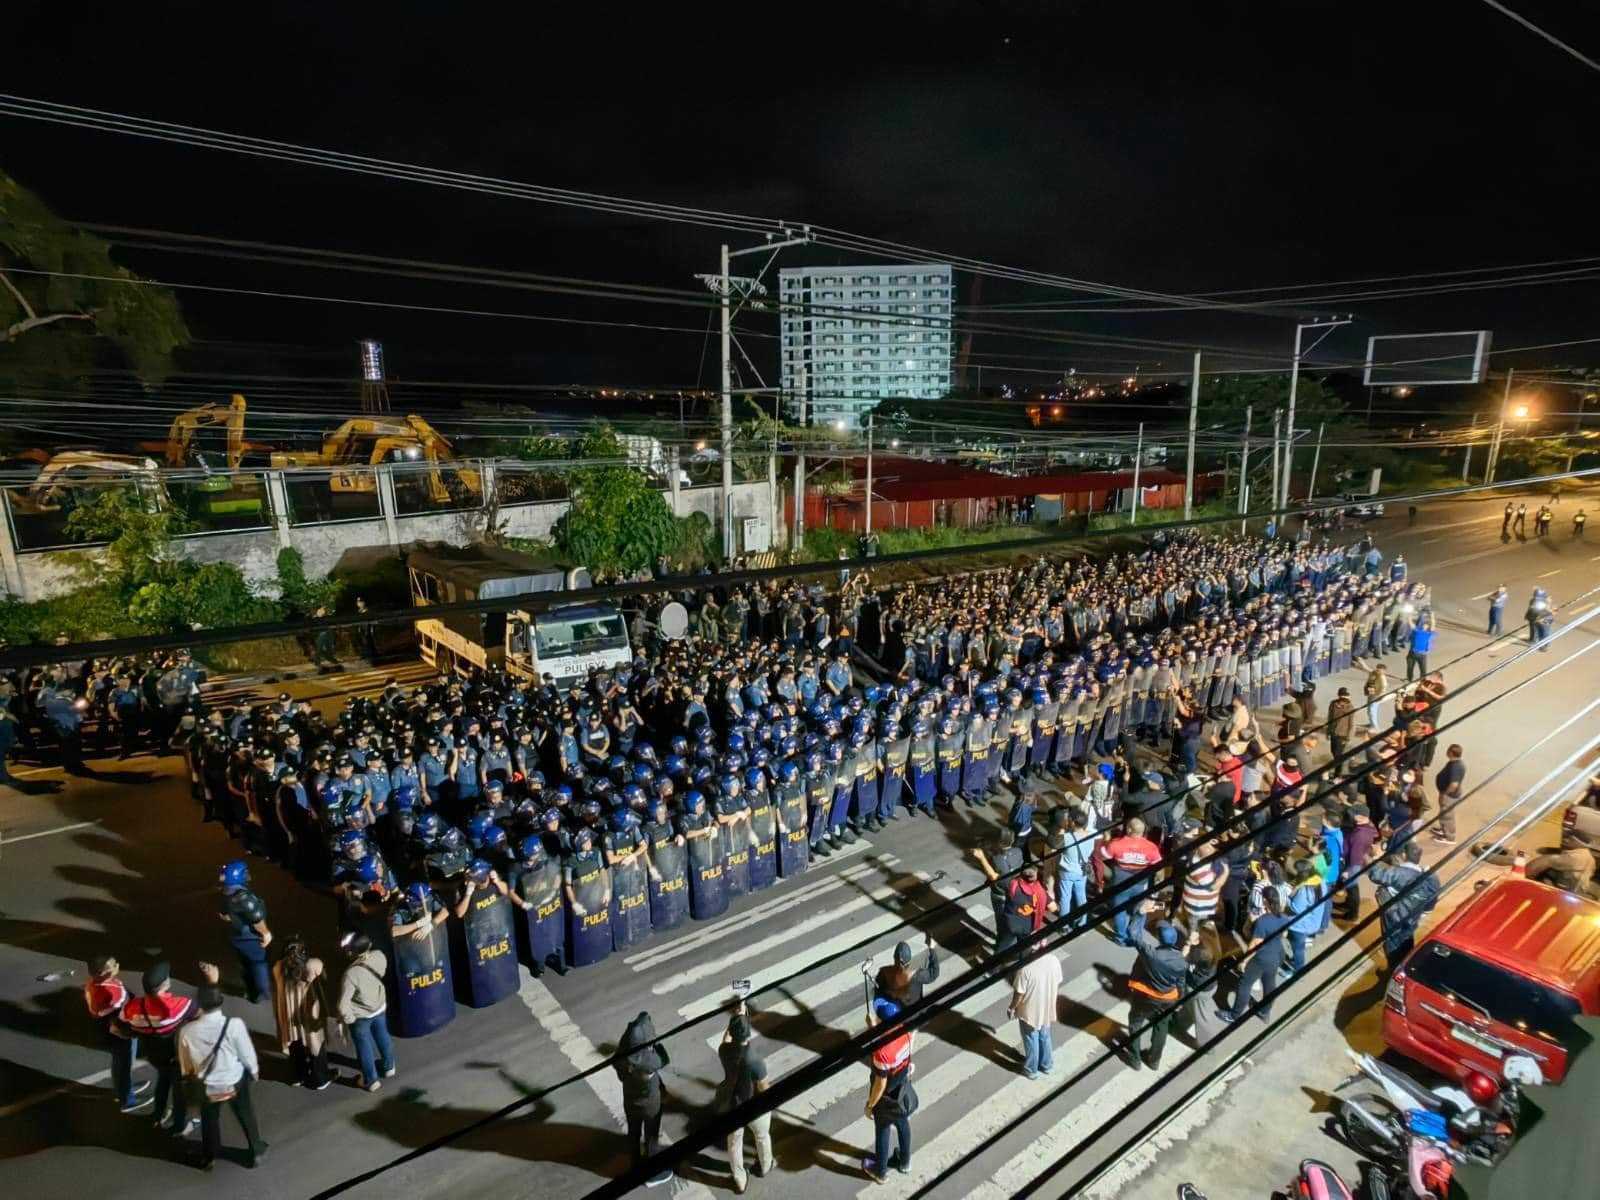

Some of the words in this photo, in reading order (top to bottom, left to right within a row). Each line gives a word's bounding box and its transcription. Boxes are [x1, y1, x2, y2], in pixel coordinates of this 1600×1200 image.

[660, 877, 684, 893] PULIS
[476, 894, 497, 911] PULIS
[584, 910, 609, 927] PULIS
[480, 939, 509, 960] PULIS
[411, 968, 443, 990] PULIS
